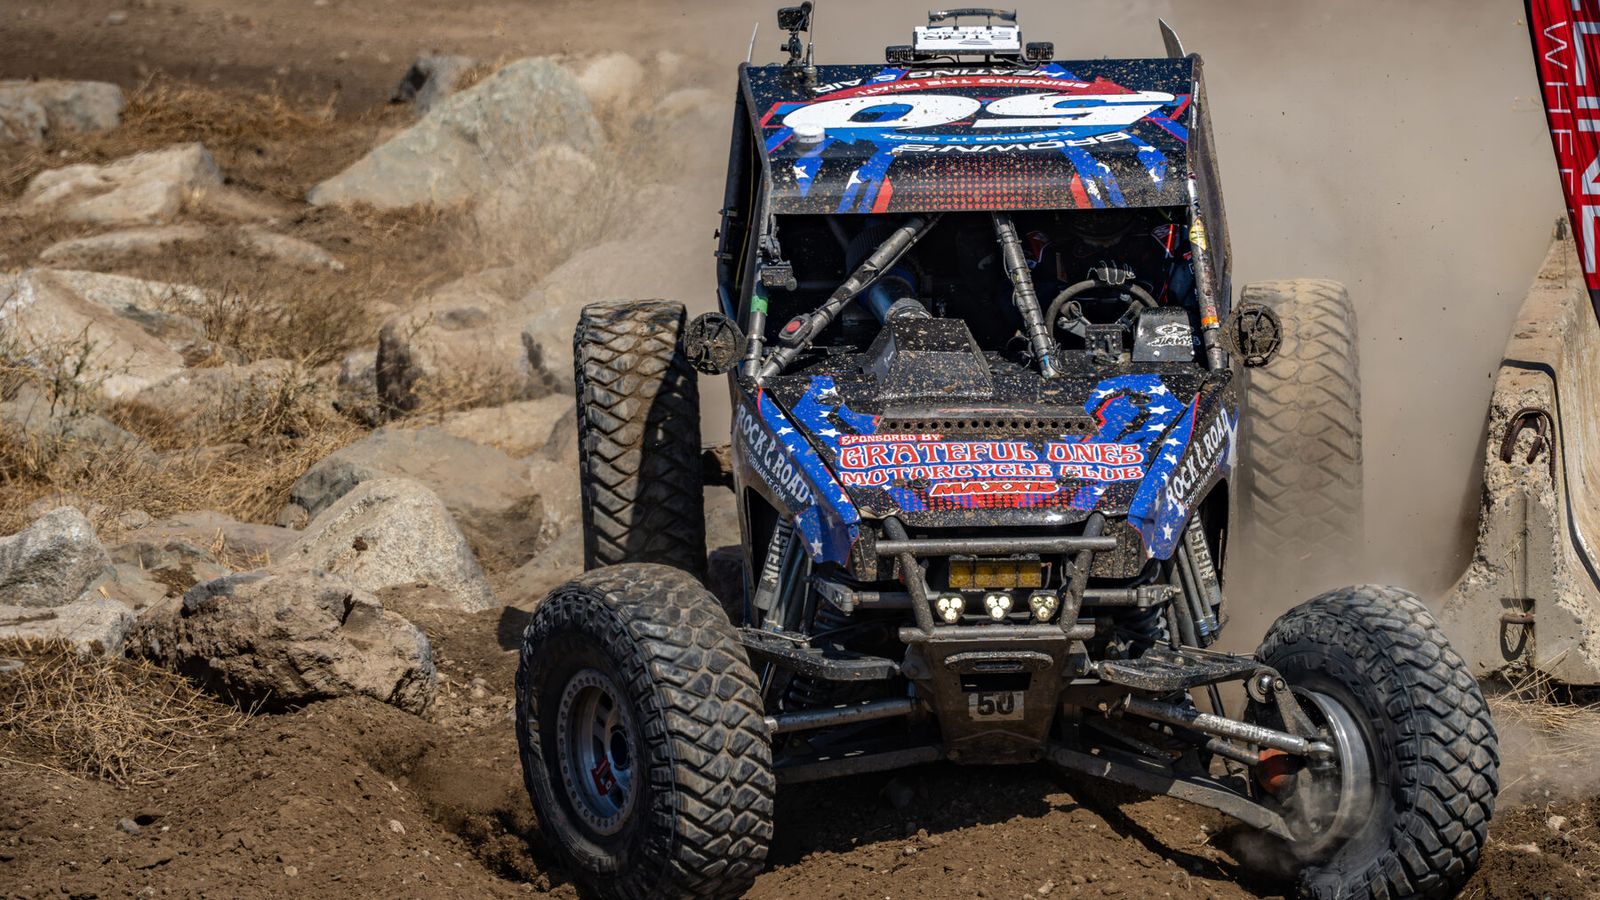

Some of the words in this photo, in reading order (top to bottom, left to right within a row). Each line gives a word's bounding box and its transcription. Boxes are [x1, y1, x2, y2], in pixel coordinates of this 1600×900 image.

[872, 73, 897, 82] &
[908, 68, 1065, 78] HEATING
[812, 78, 863, 94] AIR
[926, 78, 972, 86] THE
[979, 78, 1091, 88] BRINGING
[783, 90, 1175, 129] 50
[880, 133, 940, 142] COOL
[894, 131, 1132, 153] BROWN'S
[976, 131, 1075, 141] KEEPING
[841, 434, 916, 445] SPONSORED
[922, 433, 940, 441] BY
[737, 404, 768, 456] ROCK
[772, 453, 810, 503] ROAD
[839, 441, 1038, 469] GRATEFUL
[1047, 442, 1145, 466] ONES
[1166, 455, 1199, 511] ROCK
[1203, 408, 1229, 459] ROAD
[839, 463, 1053, 486] MOTORCYCLE
[1060, 464, 1145, 481] CLUB
[929, 480, 1060, 496] MAXXIS
[977, 690, 1015, 715] 50
